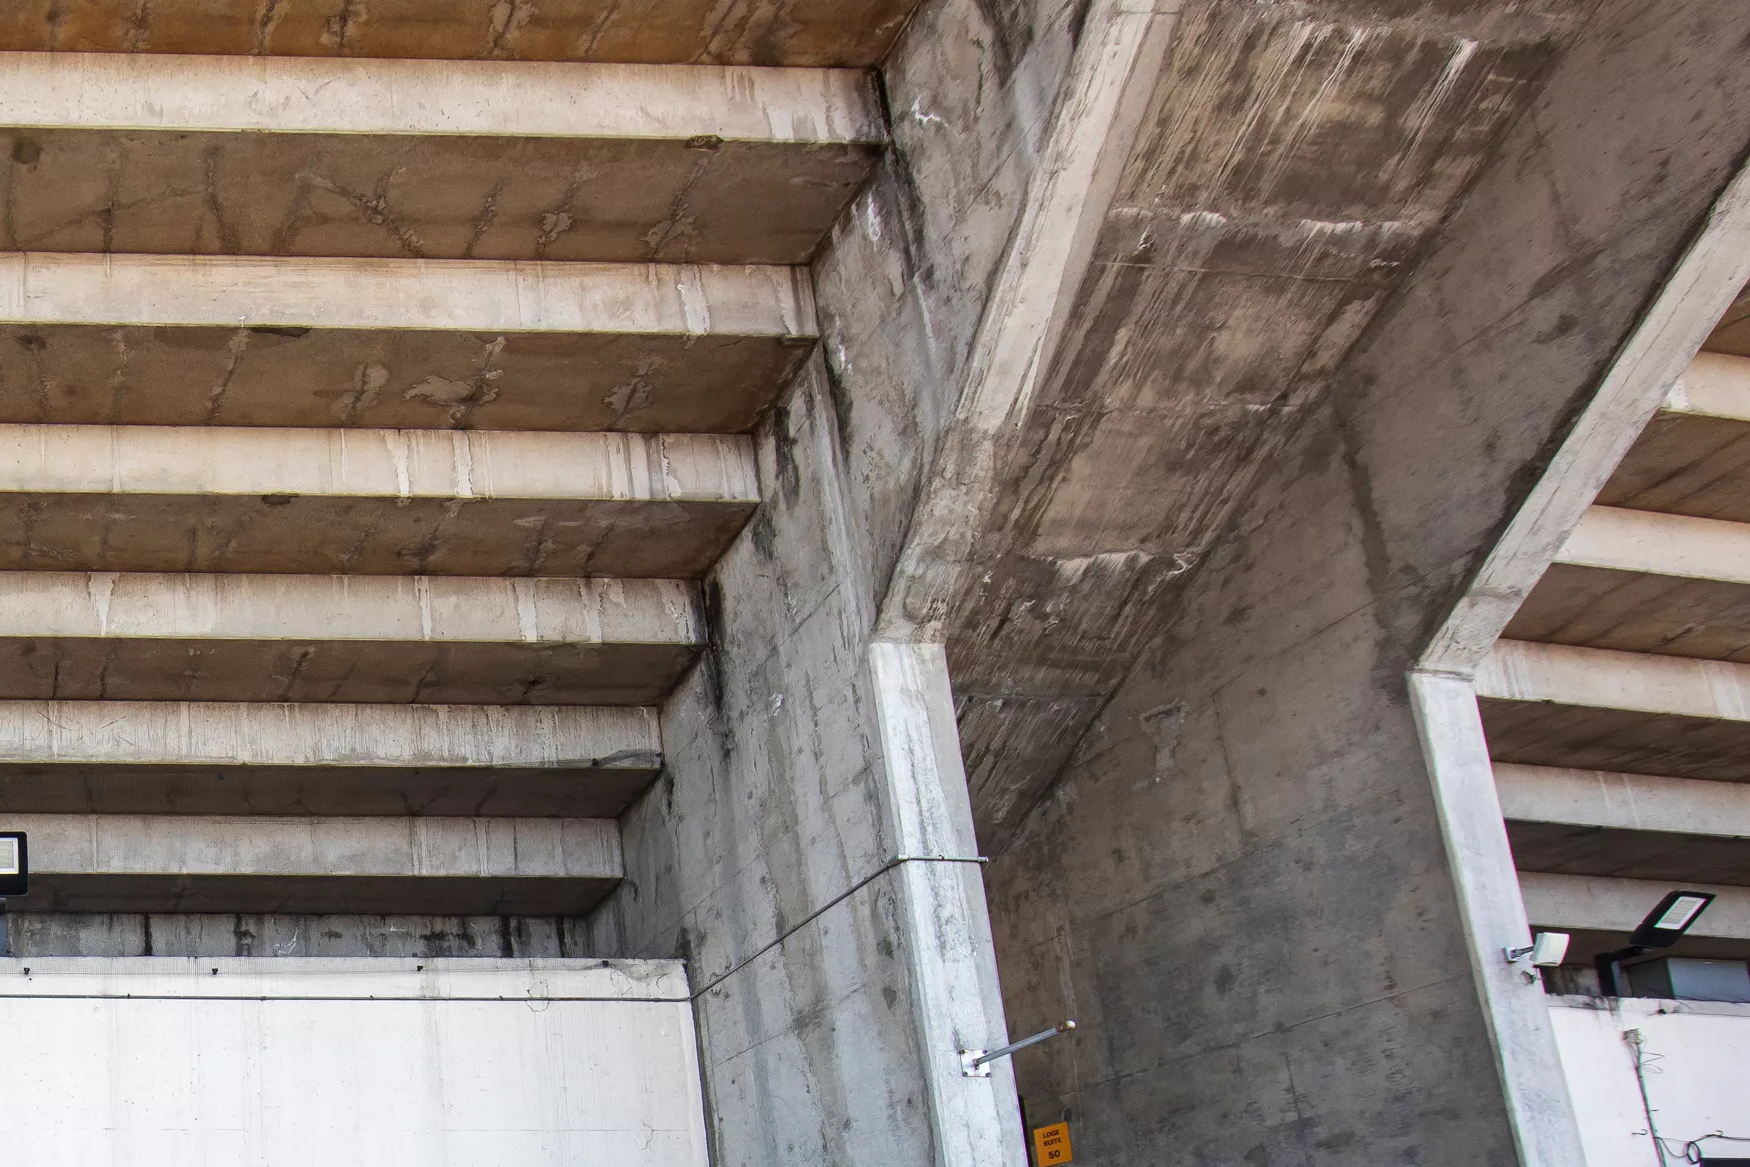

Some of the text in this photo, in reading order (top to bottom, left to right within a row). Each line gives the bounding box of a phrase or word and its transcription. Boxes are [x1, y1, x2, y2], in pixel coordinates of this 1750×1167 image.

[1042, 1129, 1060, 1138] LOGE
[1043, 1137, 1062, 1146] SUITE
[1048, 1150, 1060, 1159] 50
